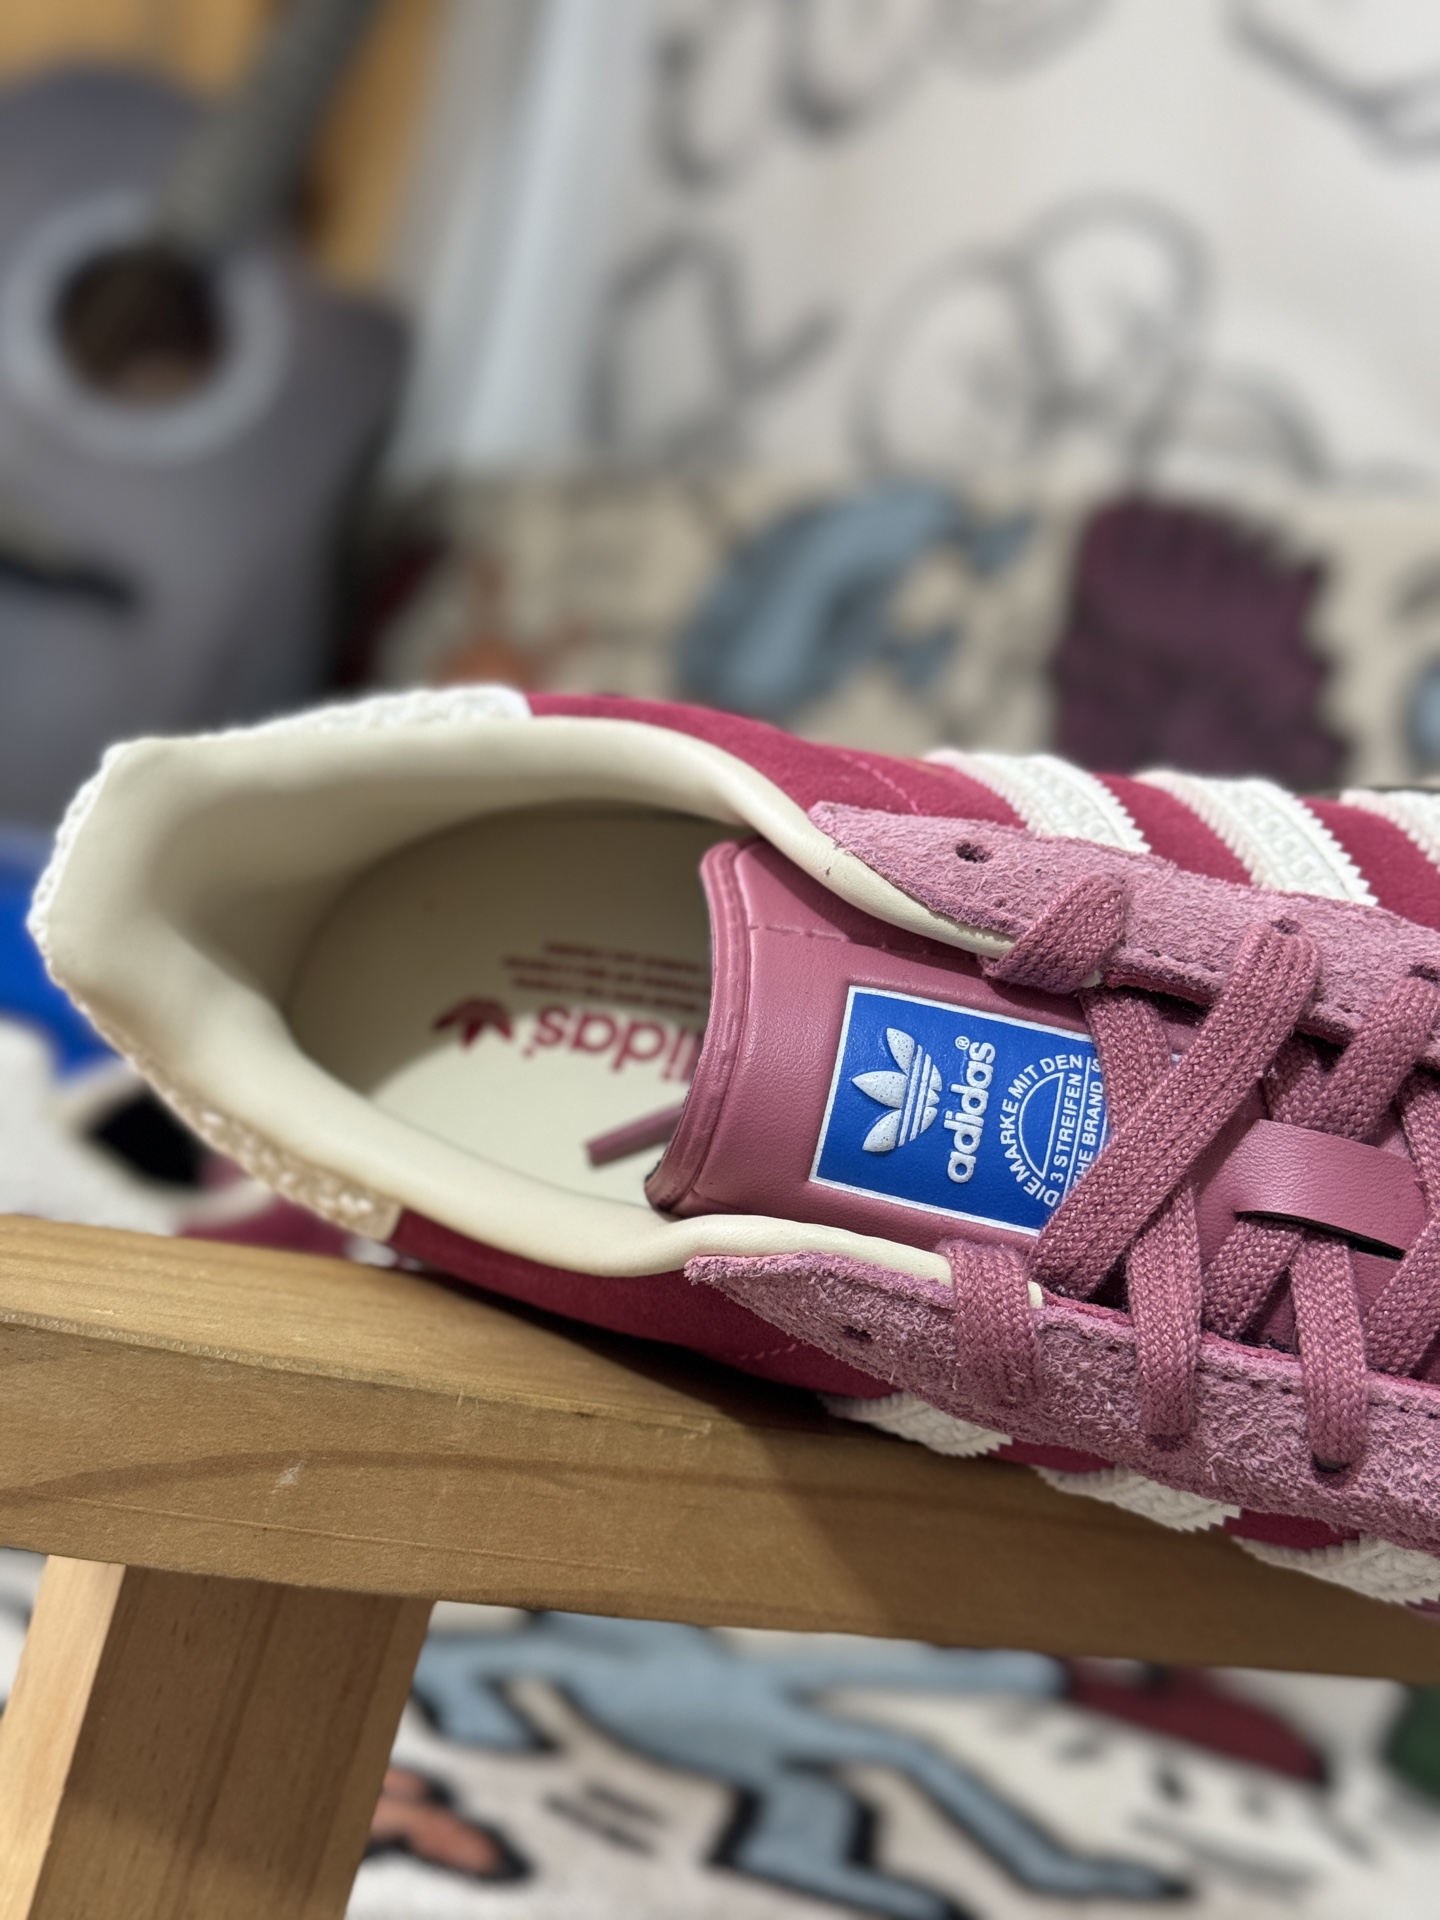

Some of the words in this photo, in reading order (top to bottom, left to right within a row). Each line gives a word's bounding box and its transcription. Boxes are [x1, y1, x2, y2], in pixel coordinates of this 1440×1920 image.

[1039, 1054, 1082, 1073] DEN
[1007, 1065, 1039, 1099] MIT
[1053, 1073, 1082, 1168] STREIFEN
[1081, 1082, 1103, 1146] BRAND
[1000, 1099, 1031, 1182] MARKE
[1023, 1175, 1060, 1207] DIE
[1050, 1172, 1064, 1183] 3
